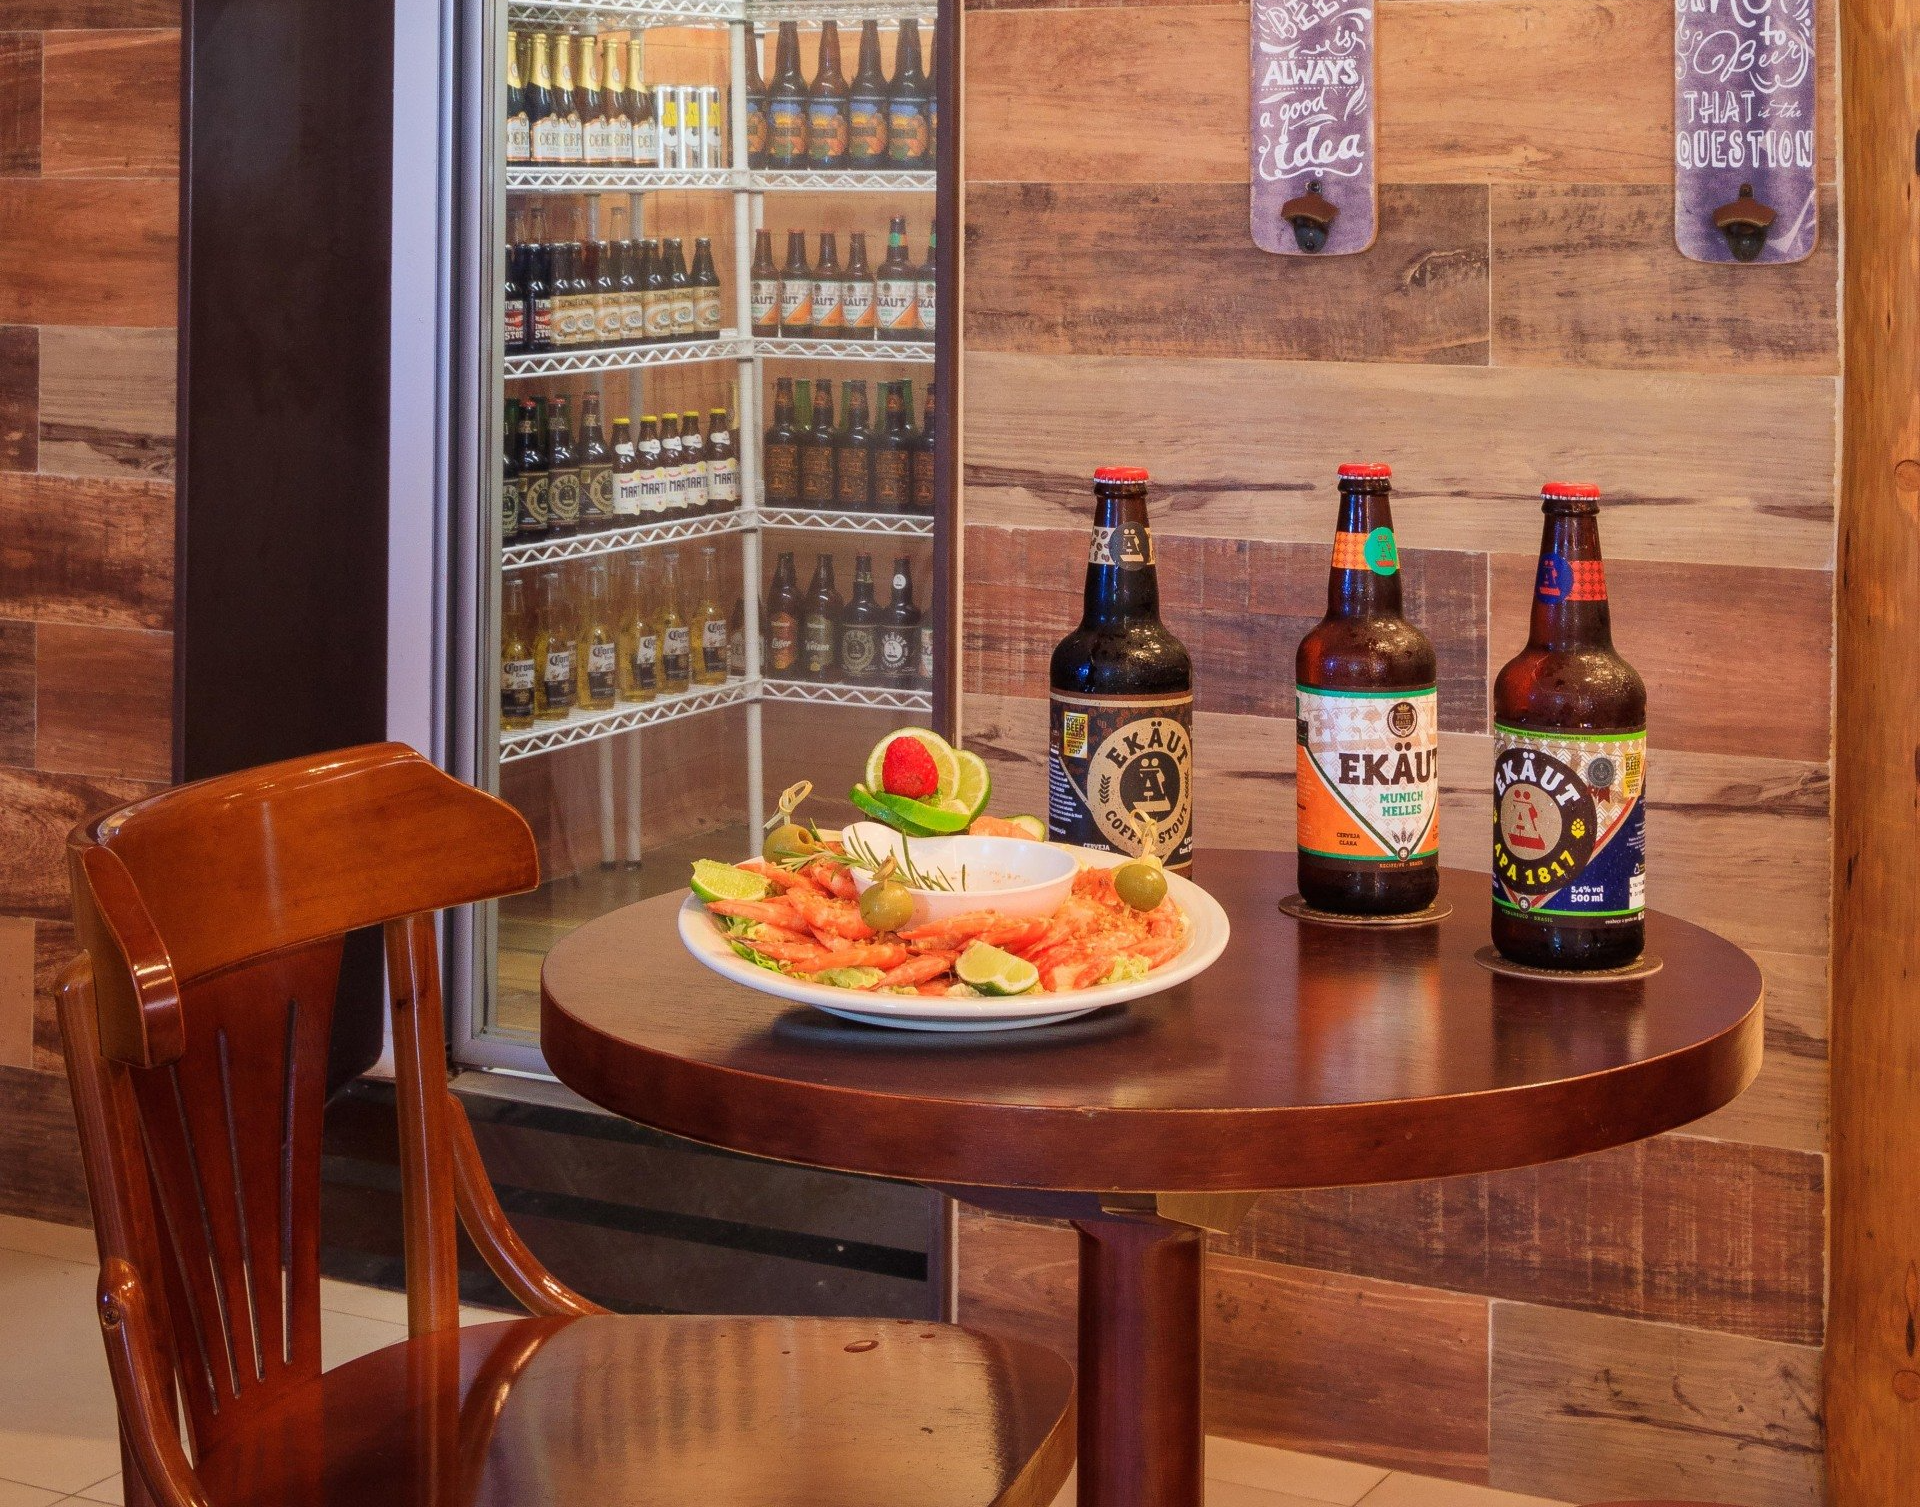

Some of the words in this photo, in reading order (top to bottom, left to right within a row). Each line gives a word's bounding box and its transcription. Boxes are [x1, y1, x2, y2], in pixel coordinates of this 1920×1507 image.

[1264, 0, 1346, 39] BEE
[1759, 15, 1787, 46] to
[1261, 59, 1359, 86] ALWAYS
[1693, 30, 1801, 83] Beer
[1260, 112, 1274, 128] a
[1279, 87, 1328, 130] good
[1684, 90, 1756, 124] THAT
[1758, 107, 1771, 118] is
[1770, 99, 1803, 118] the
[1275, 125, 1365, 170] idea
[1676, 129, 1814, 169] QUESTION
[1066, 722, 1085, 731] BEER
[1105, 720, 1189, 769] EKÄUT
[1339, 742, 1437, 785] EKÄUT
[1495, 751, 1581, 806] EKÄUT
[1380, 790, 1423, 803] MUNICH
[1382, 804, 1422, 817] HELLES
[1158, 803, 1187, 844] STOUT
[1336, 832, 1361, 840] CERVEJA
[1339, 839, 1358, 847] CLARA
[1494, 843, 1517, 880] APA
[1525, 850, 1575, 885] 1817
[1571, 885, 1591, 894] 5,4%
[1592, 885, 1604, 893] vol
[1571, 894, 1590, 903] 500
[1591, 894, 1603, 902] ml
